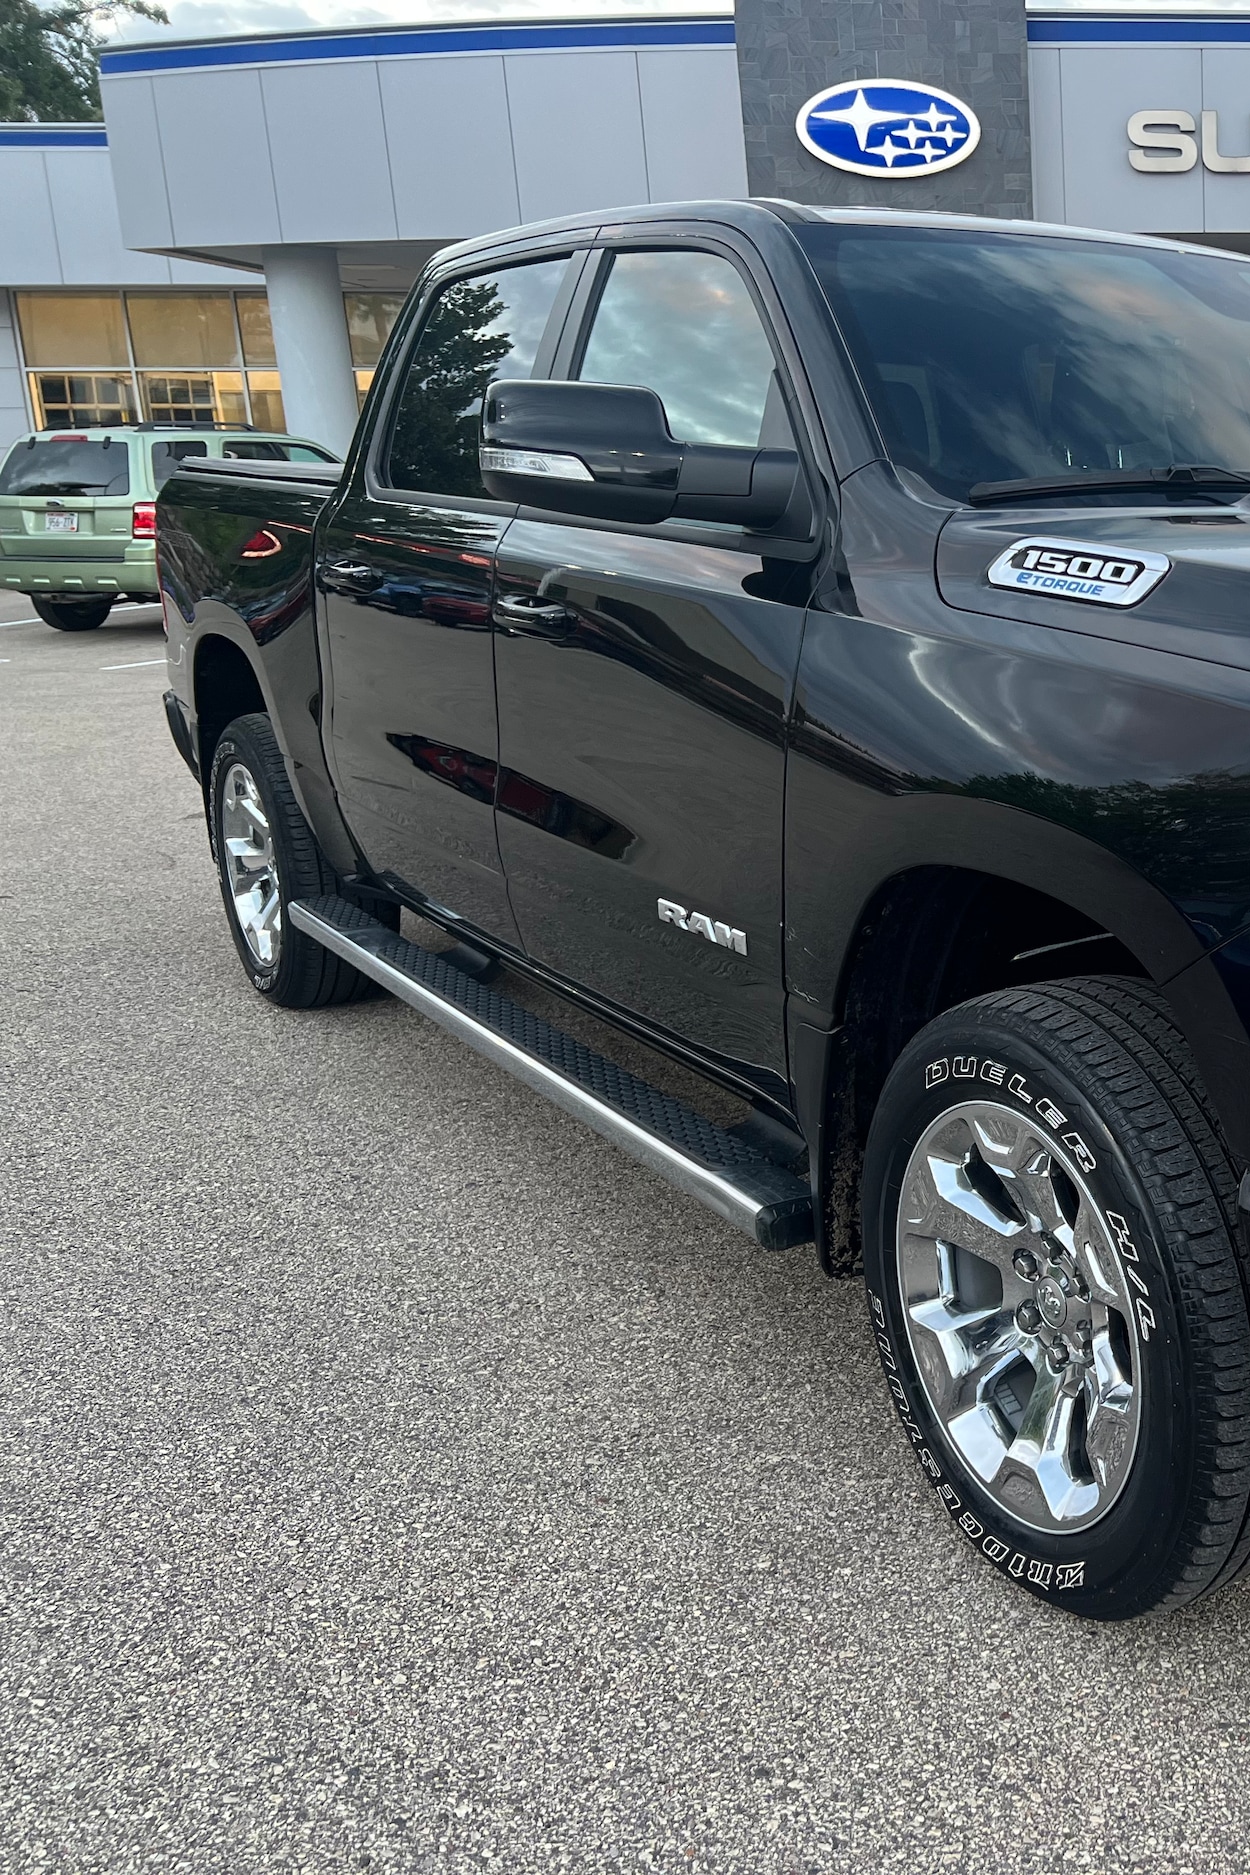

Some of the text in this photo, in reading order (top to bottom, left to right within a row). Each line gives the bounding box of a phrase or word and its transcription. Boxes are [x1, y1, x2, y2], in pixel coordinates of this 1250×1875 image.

[1022, 550, 1139, 583] 1500
[657, 898, 748, 956] RAM
[925, 1056, 1097, 1173] DUELER
